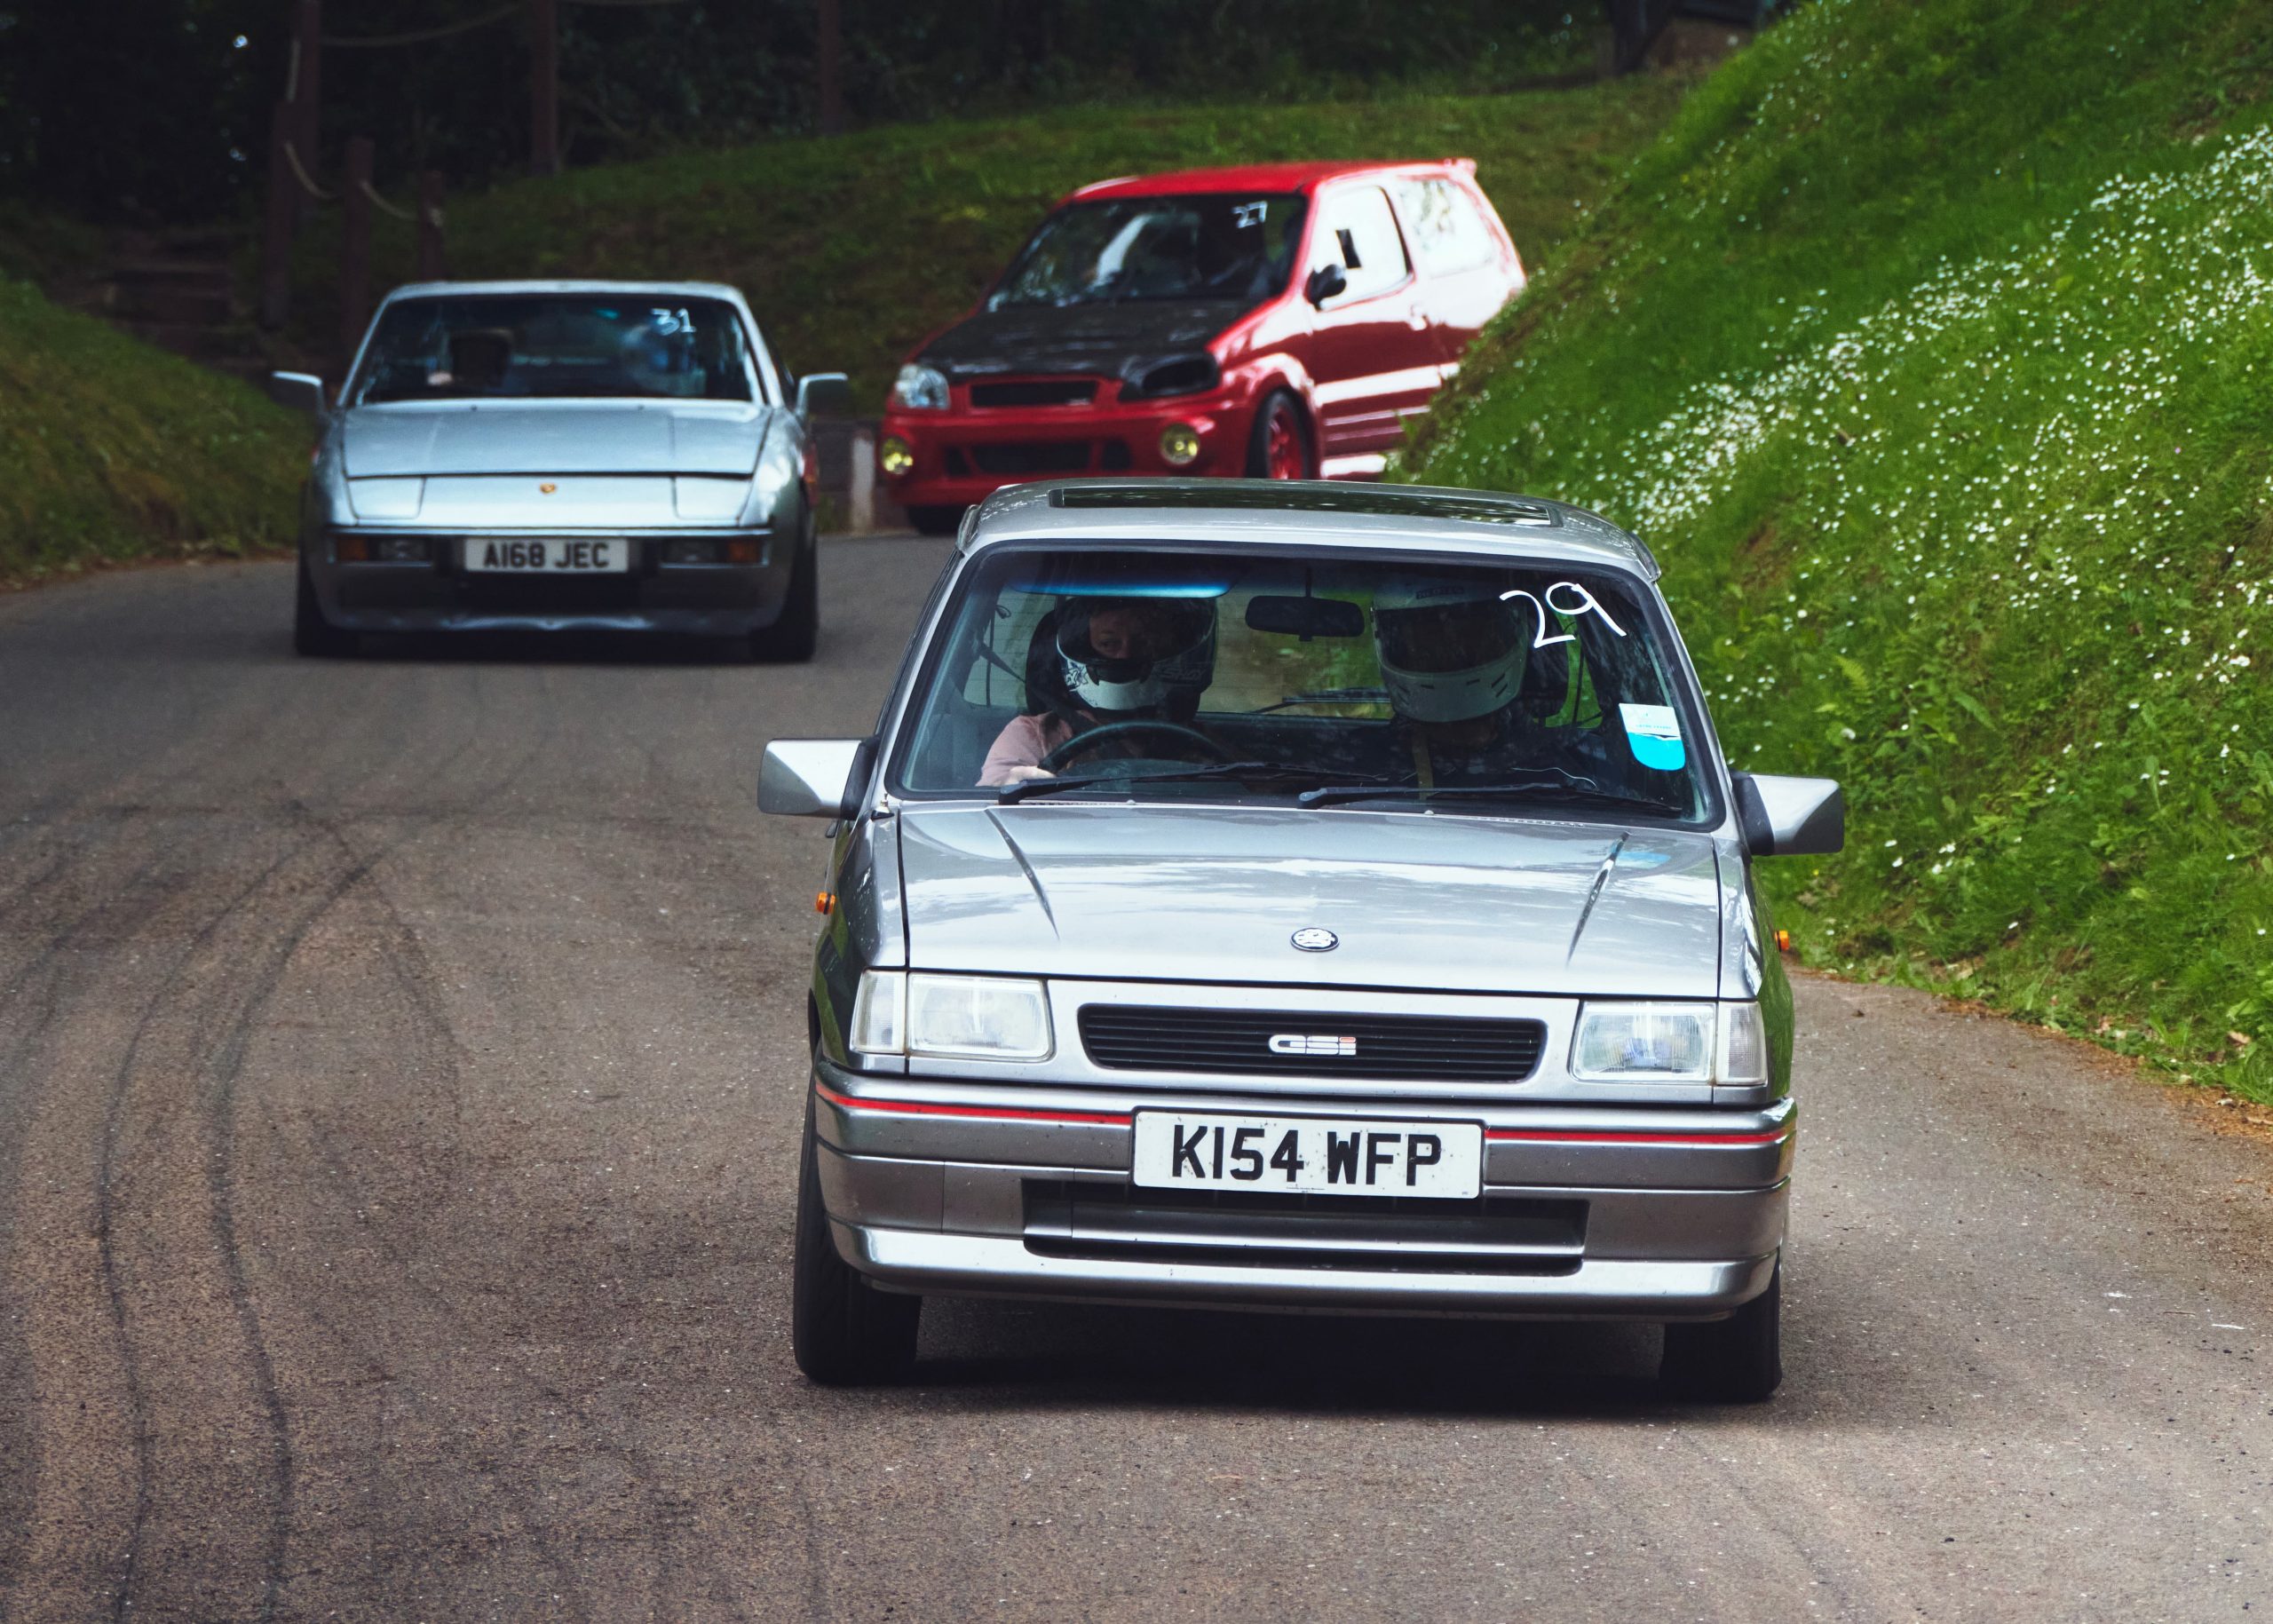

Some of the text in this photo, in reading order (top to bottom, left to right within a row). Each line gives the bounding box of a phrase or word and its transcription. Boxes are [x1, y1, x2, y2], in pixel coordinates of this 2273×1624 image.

[1231, 201, 1268, 228] 27
[651, 307, 697, 336] 31
[484, 543, 609, 568] A168 JEC
[1499, 582, 1627, 648] 29
[1172, 1124, 1441, 1186] K154 WFP
